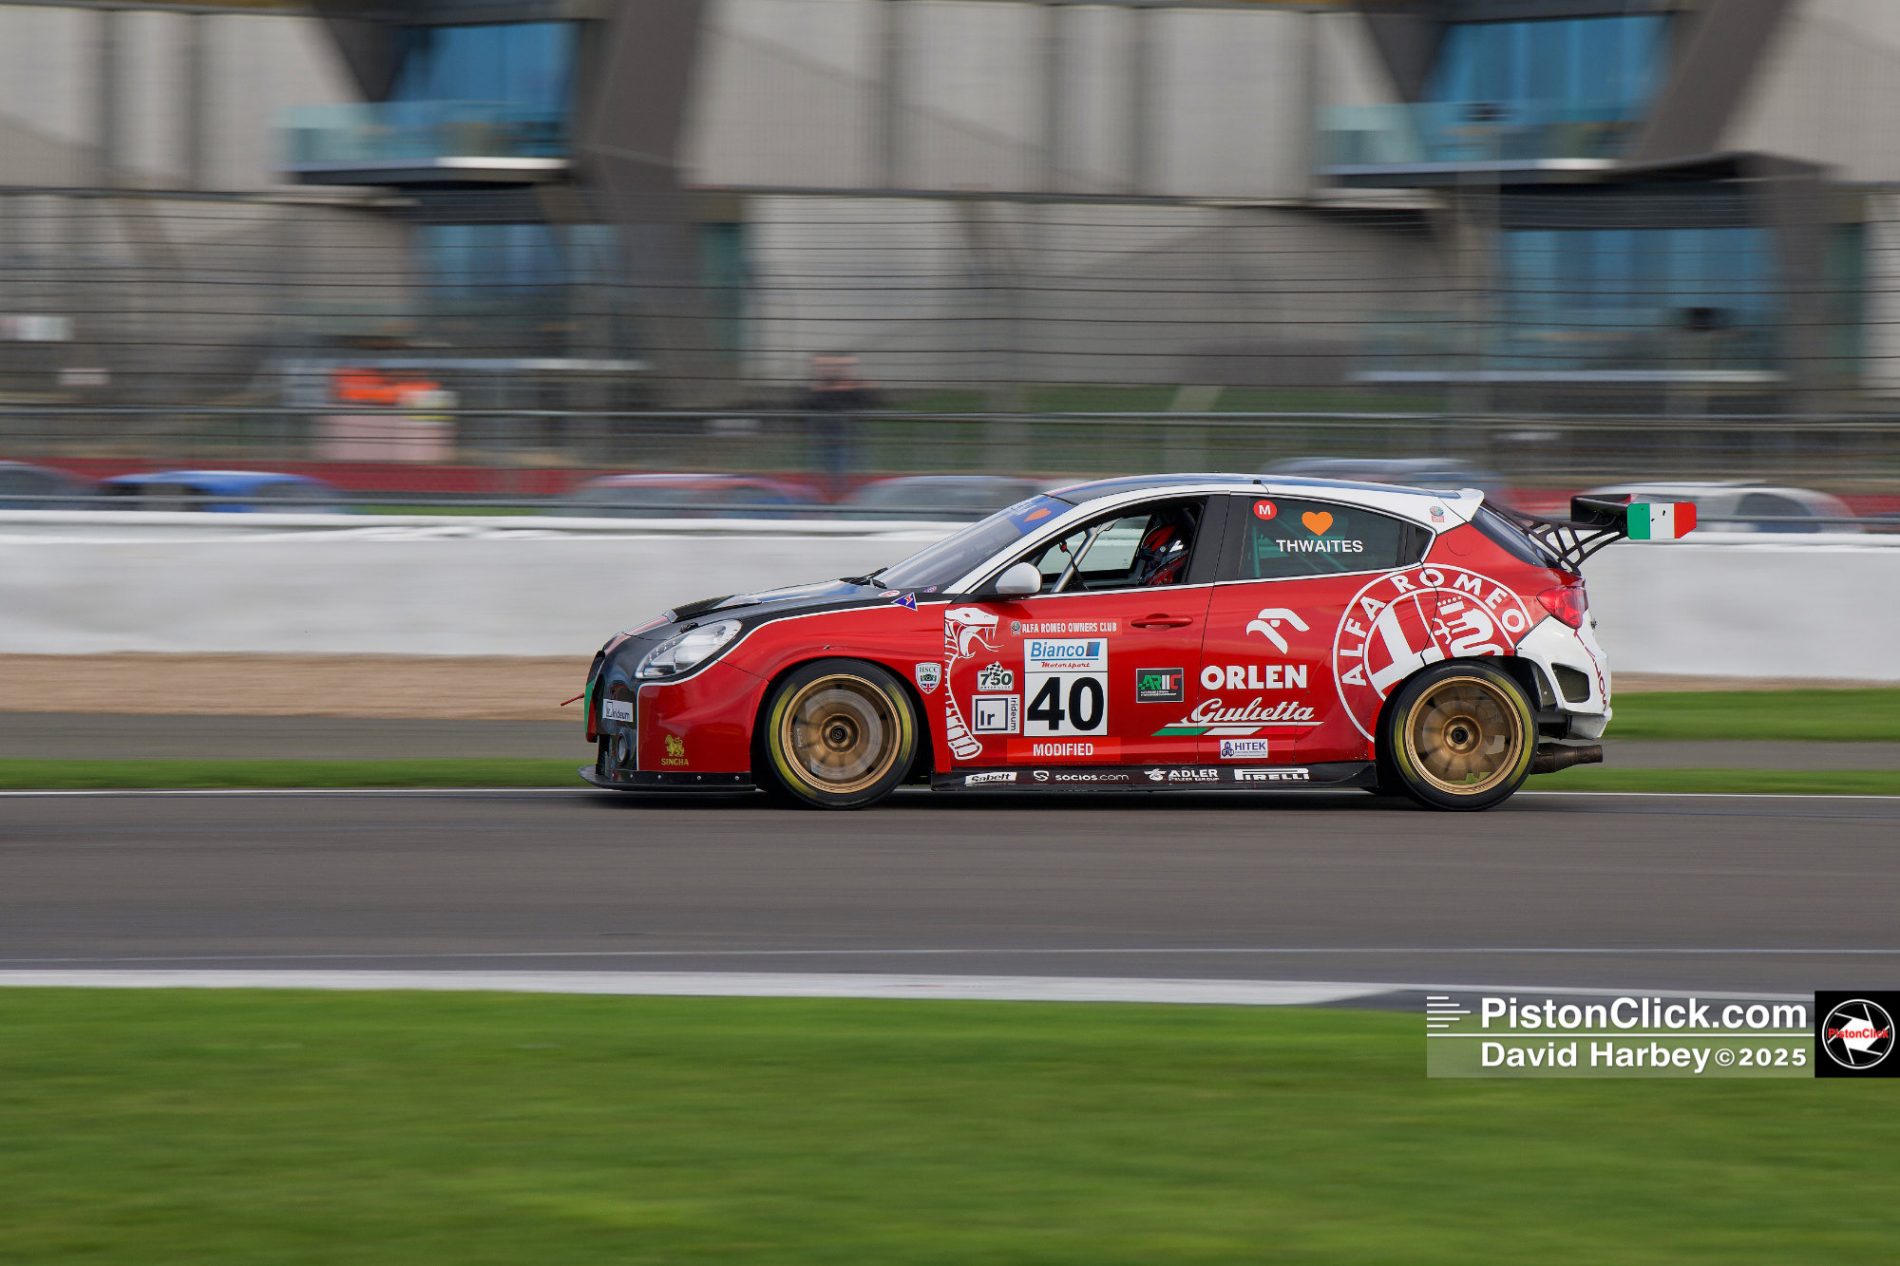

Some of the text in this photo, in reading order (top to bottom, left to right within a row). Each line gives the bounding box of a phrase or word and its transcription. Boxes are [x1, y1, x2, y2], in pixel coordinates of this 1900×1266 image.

[1258, 505, 1270, 515] M
[1276, 540, 1364, 552] THWAITES
[1022, 622, 1116, 633] ALFA ROMEO OWNERS CLUB
[1340, 569, 1525, 686] ALFA ROMEO
[1031, 642, 1084, 657] Bianco
[981, 673, 1012, 686] 750
[1201, 665, 1307, 690] ORLEN
[1027, 676, 1104, 731] 40
[1180, 697, 1314, 723] Giulietta
[1010, 697, 1018, 731] Irideum
[1033, 743, 1094, 756] MODIFIED
[1235, 742, 1266, 750] HITEK
[1055, 773, 1129, 781] socios.com
[1168, 769, 1218, 778] ADLER
[1234, 768, 1310, 780] PIRELLI
